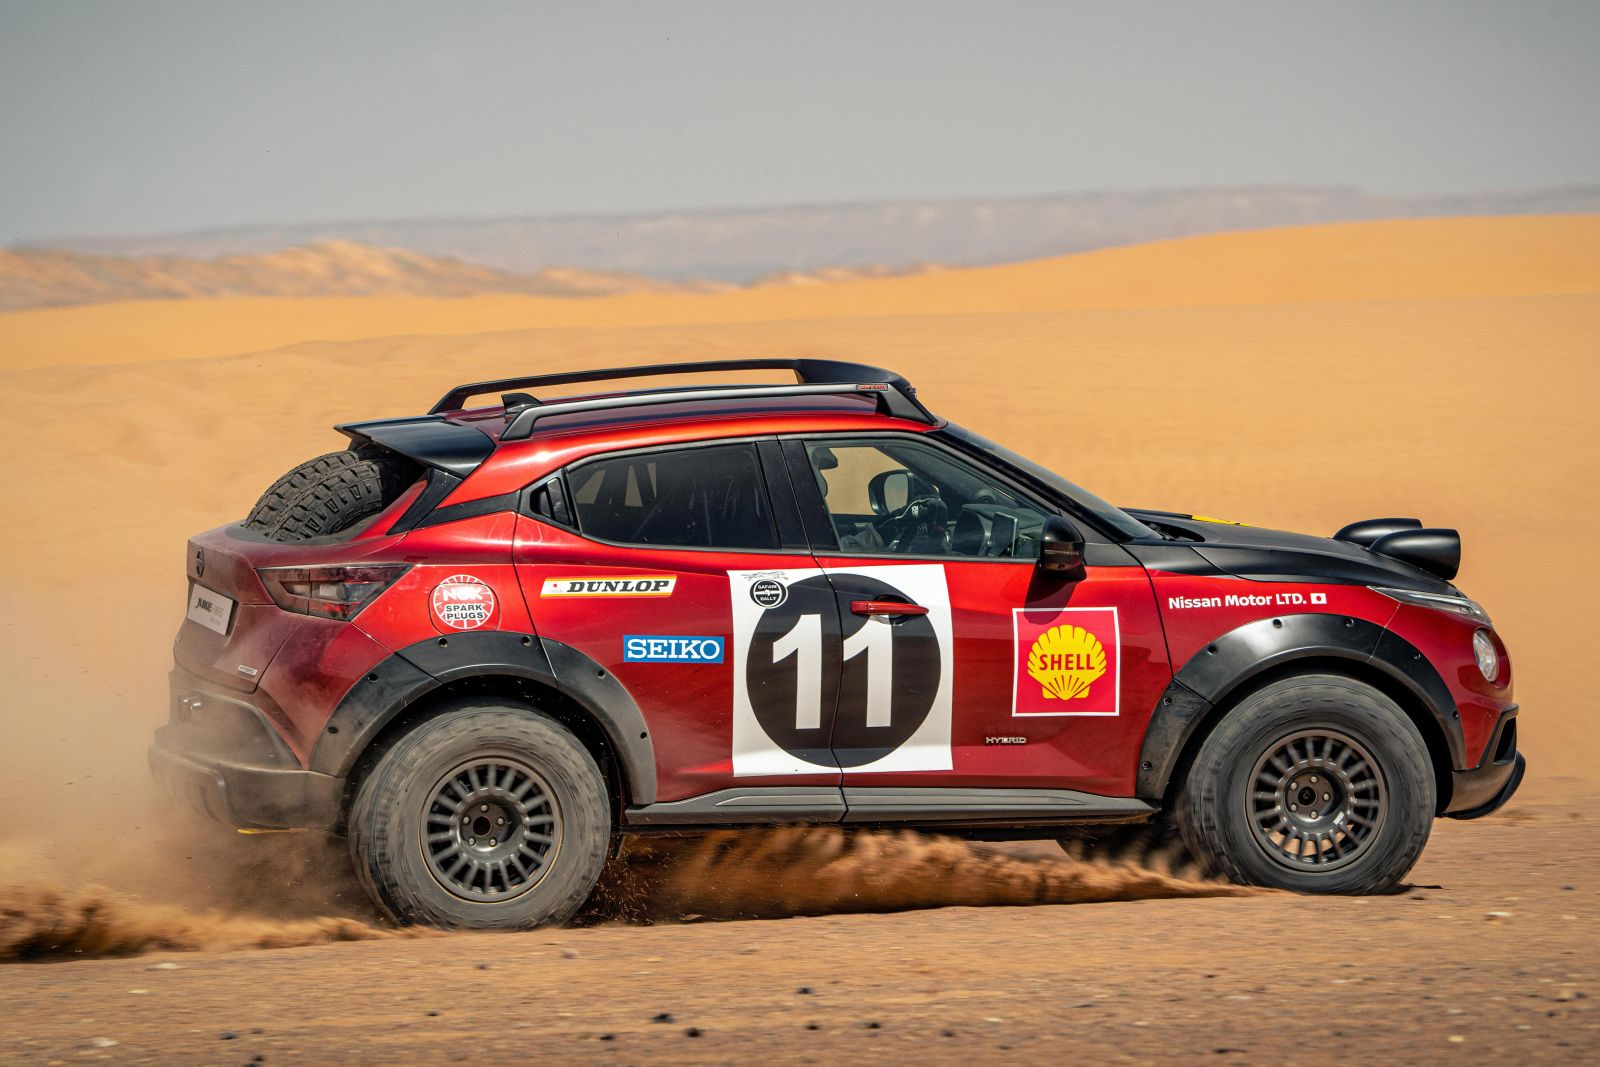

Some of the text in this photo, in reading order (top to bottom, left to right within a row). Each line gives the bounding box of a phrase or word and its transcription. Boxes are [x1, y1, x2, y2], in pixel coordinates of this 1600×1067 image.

[442, 586, 483, 601] NGK
[567, 580, 669, 593] DUNLOP
[445, 604, 483, 612] SPARK
[1168, 593, 1307, 609] Nissan Motor LTD.
[627, 638, 720, 660] SEIKO
[1039, 653, 1095, 670] SHELL
[772, 613, 893, 730] 11
[985, 736, 1027, 744] HYBRID
